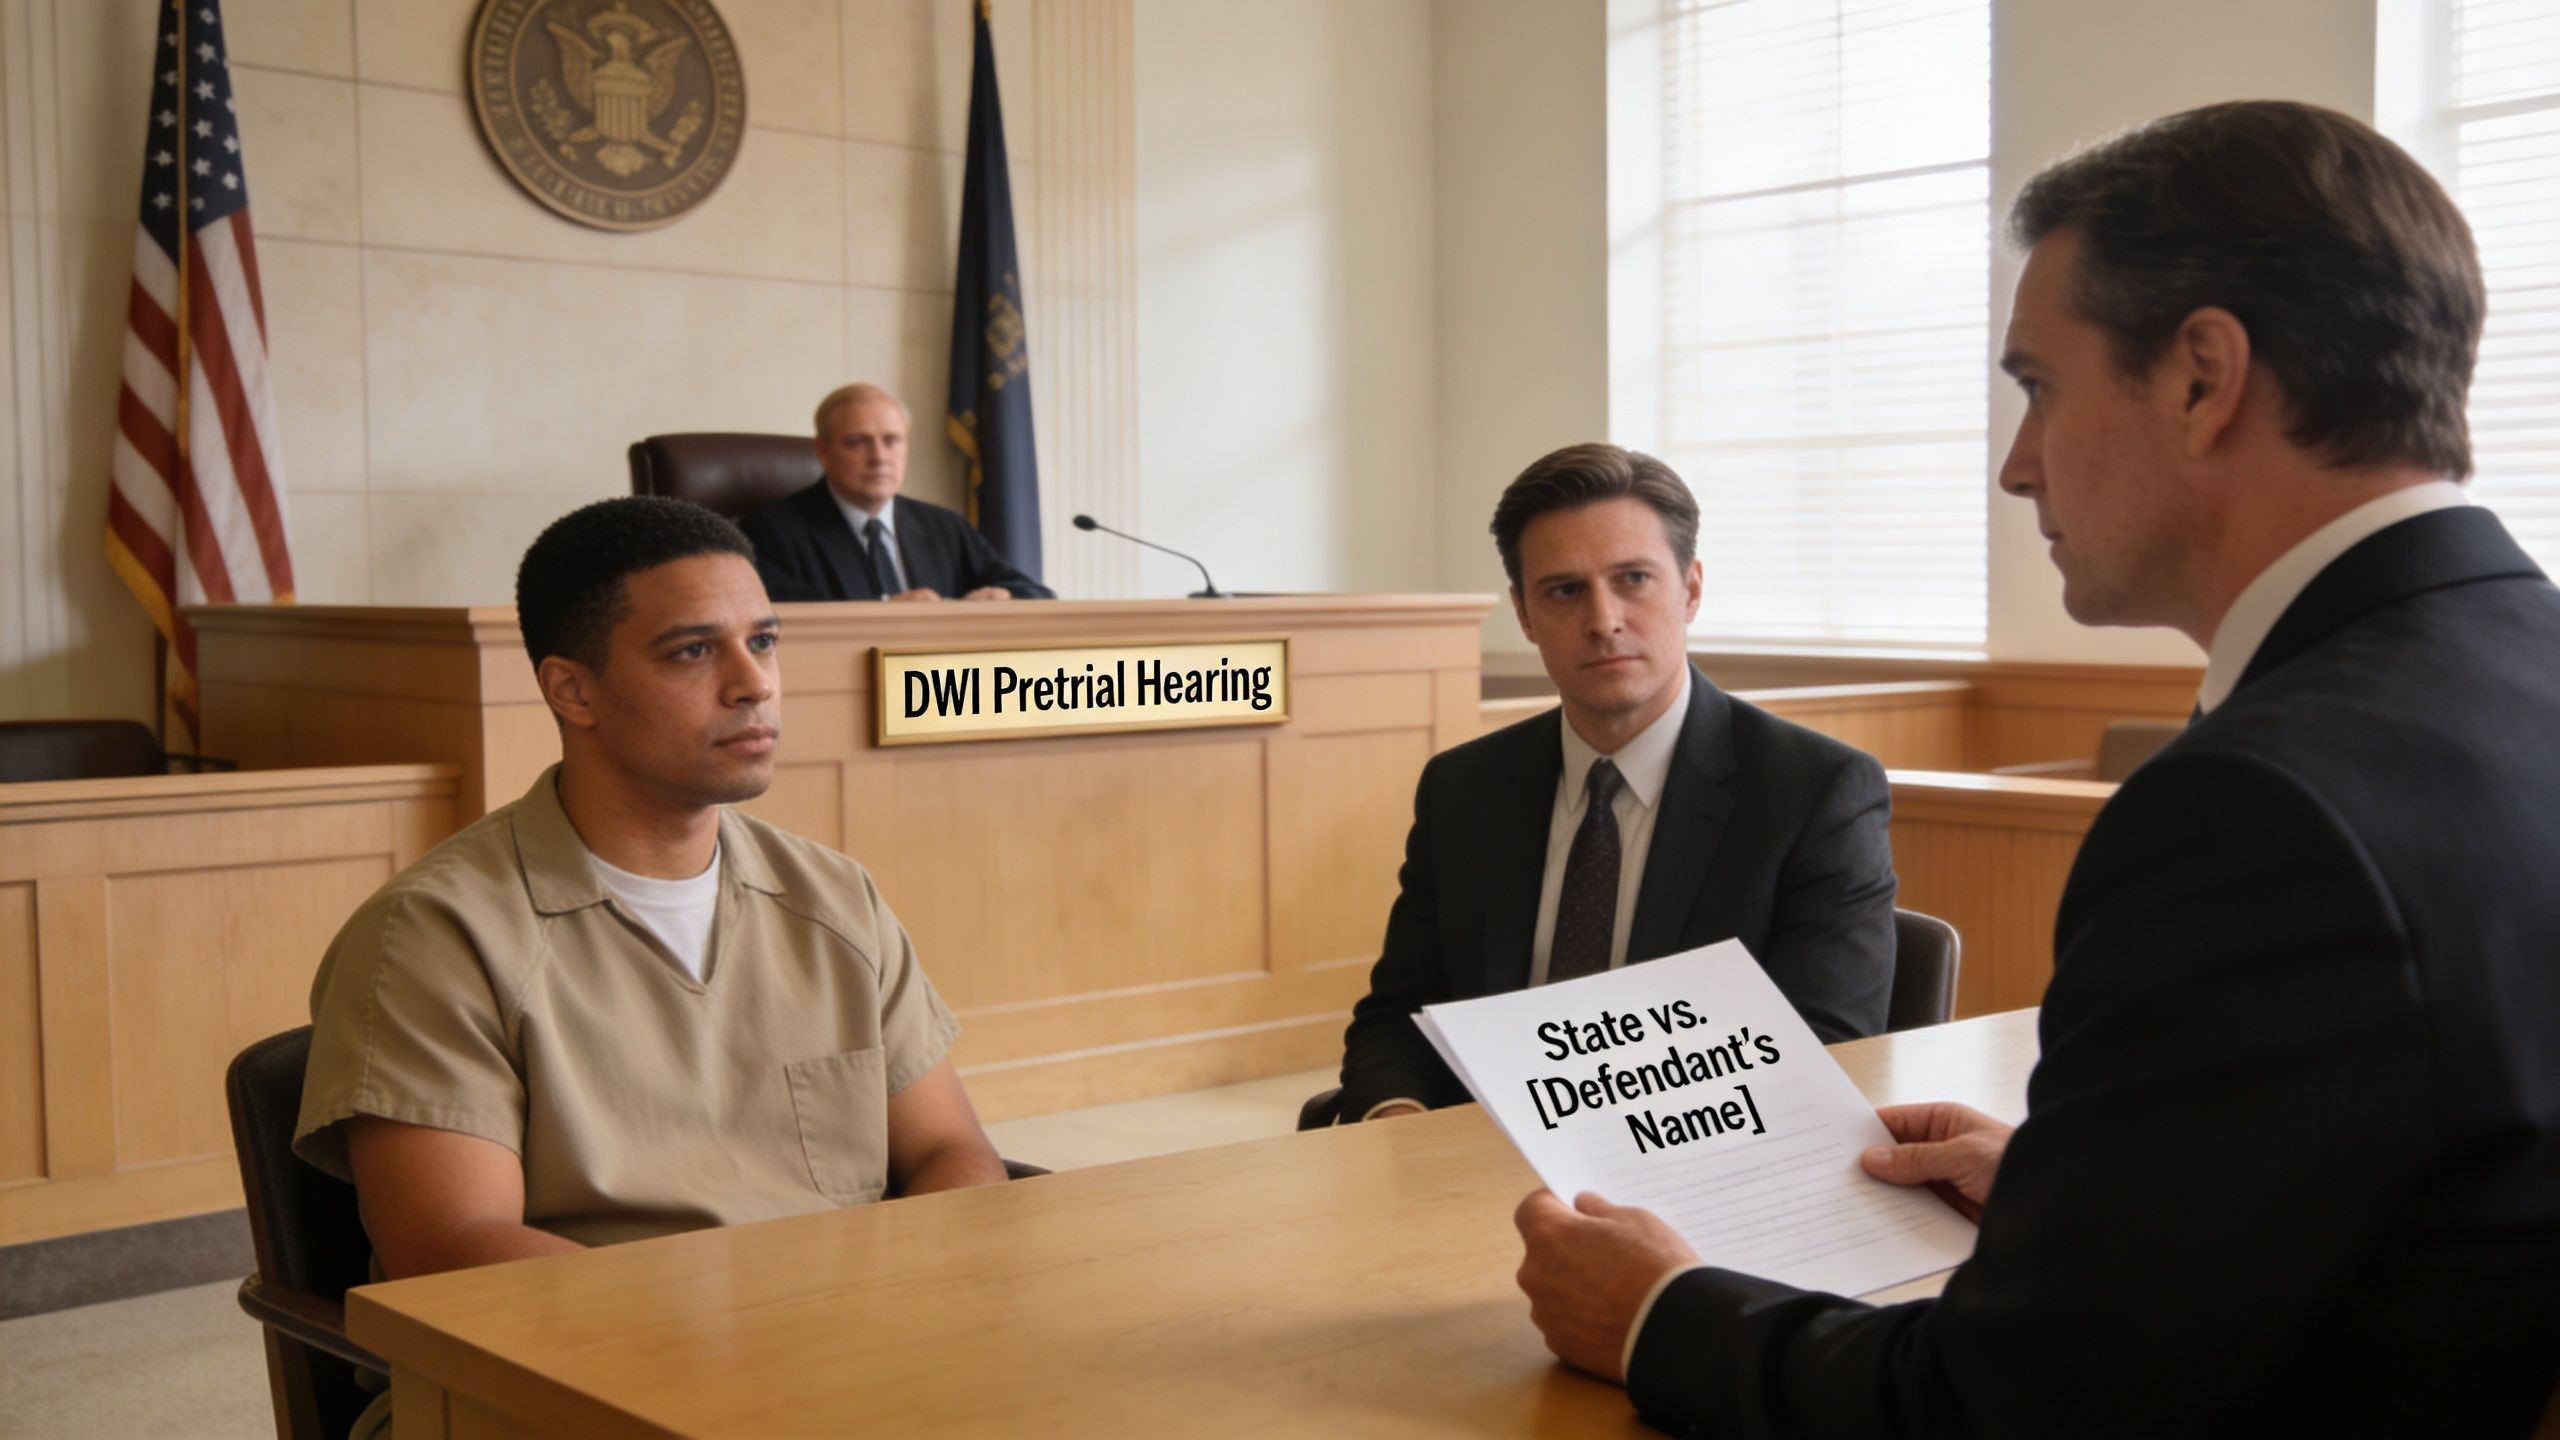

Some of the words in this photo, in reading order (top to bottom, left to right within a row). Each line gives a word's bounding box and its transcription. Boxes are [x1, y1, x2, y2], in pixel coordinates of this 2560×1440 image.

[904, 667, 980, 718] DWI
[993, 660, 1125, 714] Pretrial
[1137, 657, 1272, 711] Hearing
[1537, 1010, 1645, 1061] State
[1647, 1000, 1708, 1035] vs.
[1625, 1084, 1766, 1154] Name]
